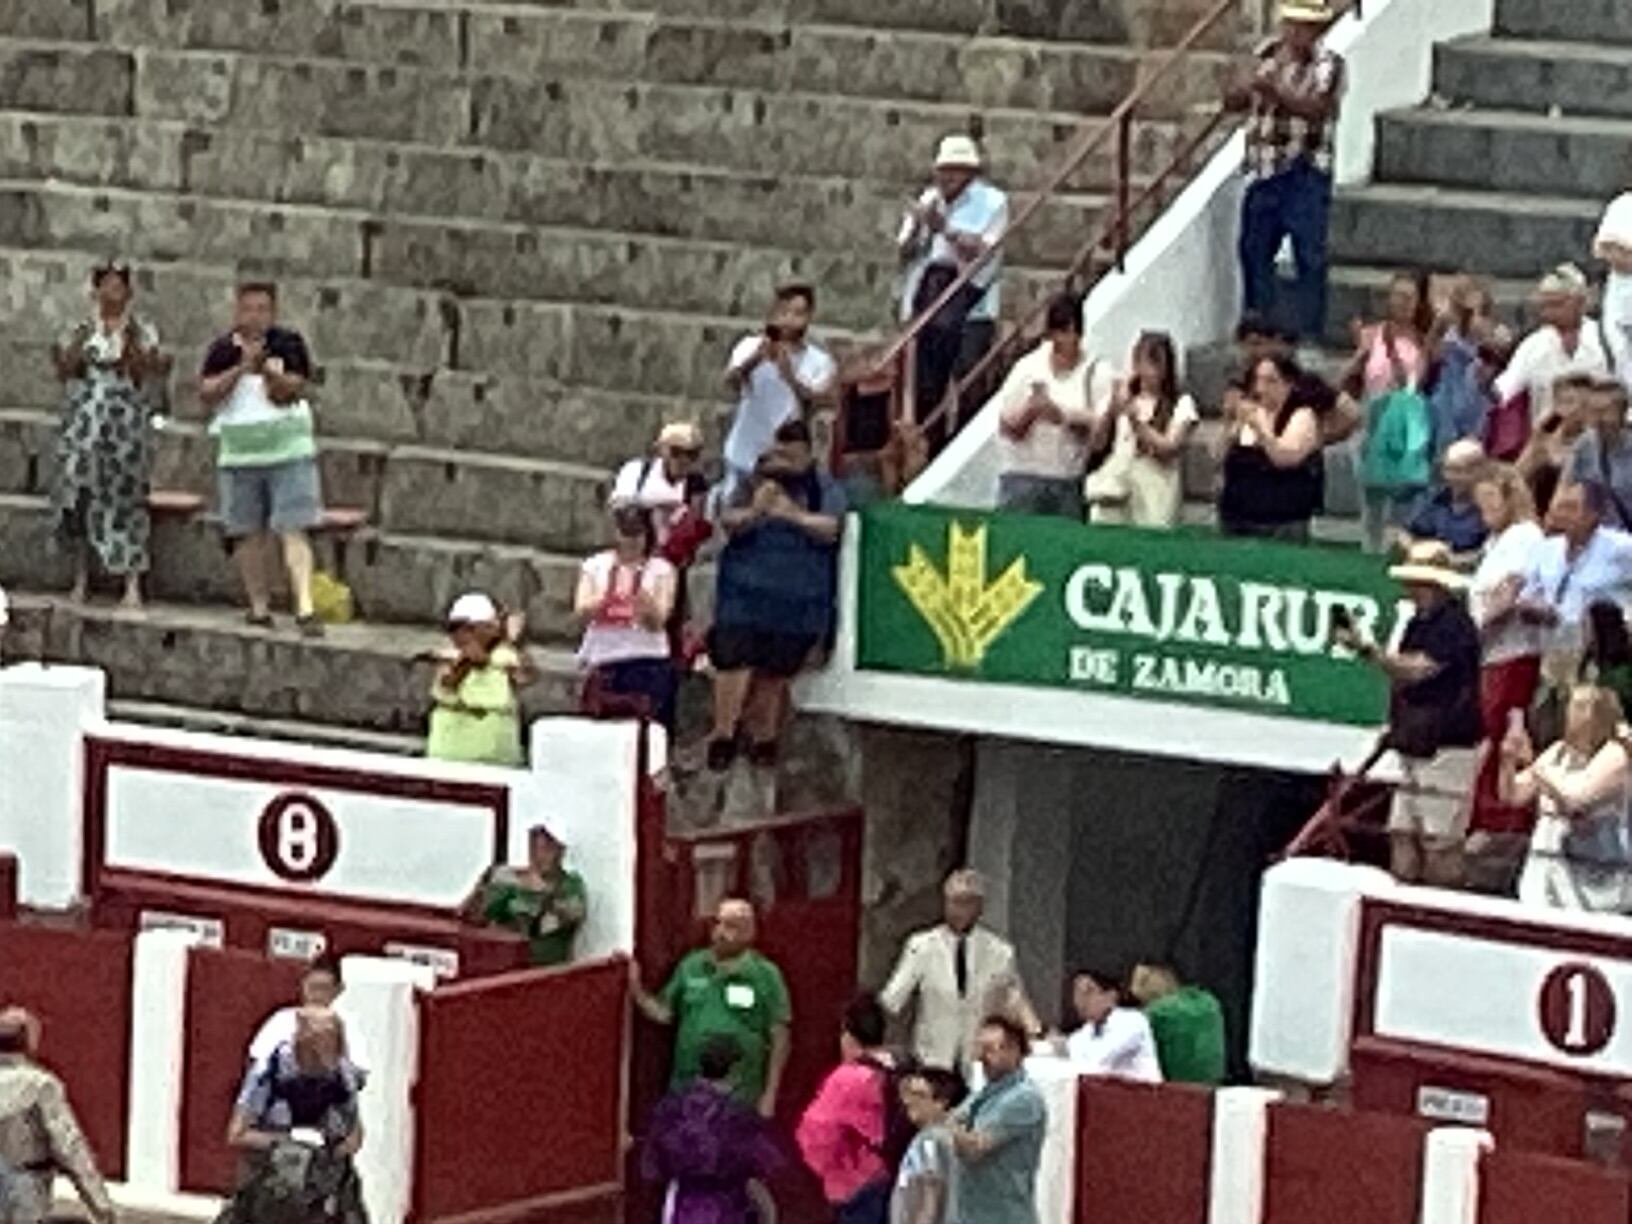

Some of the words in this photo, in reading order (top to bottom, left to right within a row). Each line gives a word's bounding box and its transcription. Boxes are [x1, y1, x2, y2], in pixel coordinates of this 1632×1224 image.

[1066, 564, 1229, 644] CAJA
[1069, 647, 1116, 683] DE
[1132, 655, 1290, 703] ZAMORA
[278, 804, 317, 870] 8
[1565, 973, 1587, 1046] 1
